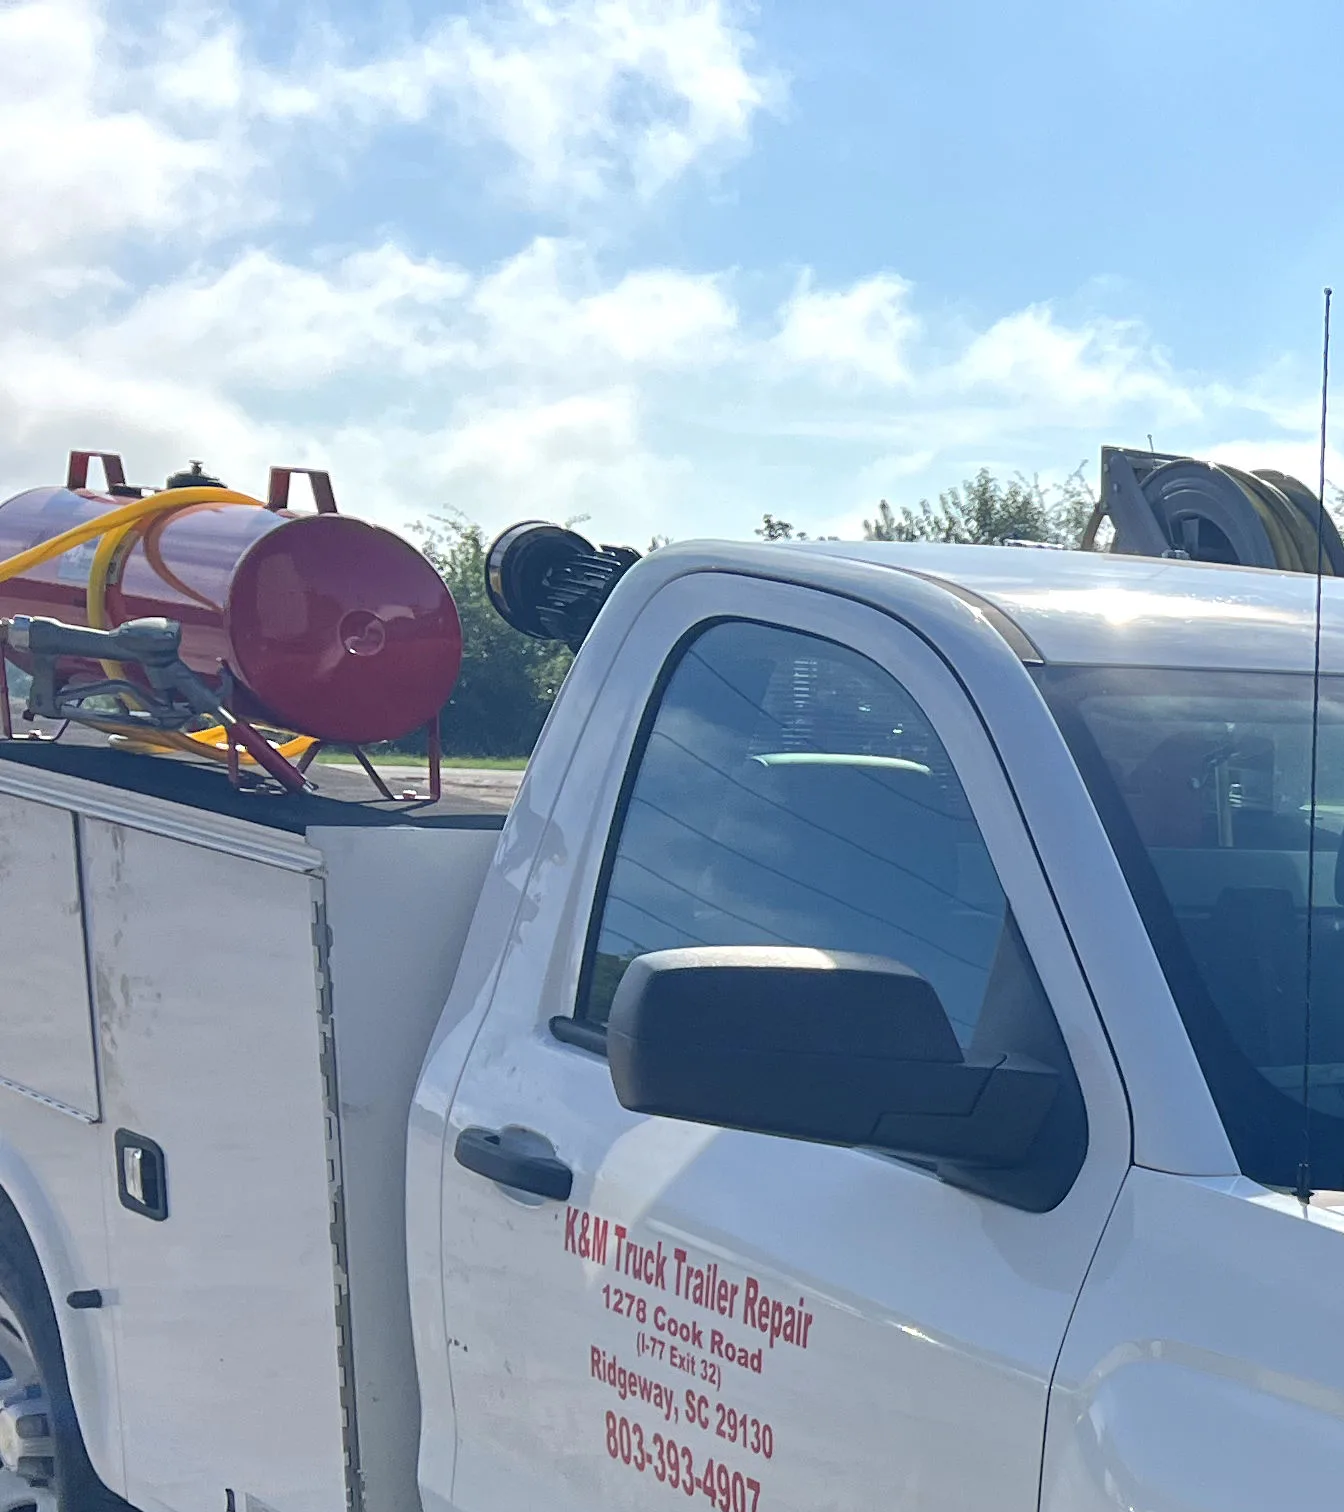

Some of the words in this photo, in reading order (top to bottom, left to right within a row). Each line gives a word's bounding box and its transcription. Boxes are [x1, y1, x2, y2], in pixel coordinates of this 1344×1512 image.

[563, 1205, 609, 1266] K&M
[614, 1223, 668, 1291] Truck
[674, 1247, 739, 1319] Trailer
[743, 1276, 813, 1349] Repair
[602, 1283, 648, 1324] 1278
[653, 1305, 704, 1350] Cook
[710, 1328, 763, 1375] Road
[590, 1344, 679, 1425] Ridgeway,
[685, 1388, 710, 1431] SC
[715, 1402, 774, 1460] 29130
[636, 1331, 666, 1361] (I-77
[670, 1345, 697, 1377] Exit
[700, 1359, 722, 1393] 32)
